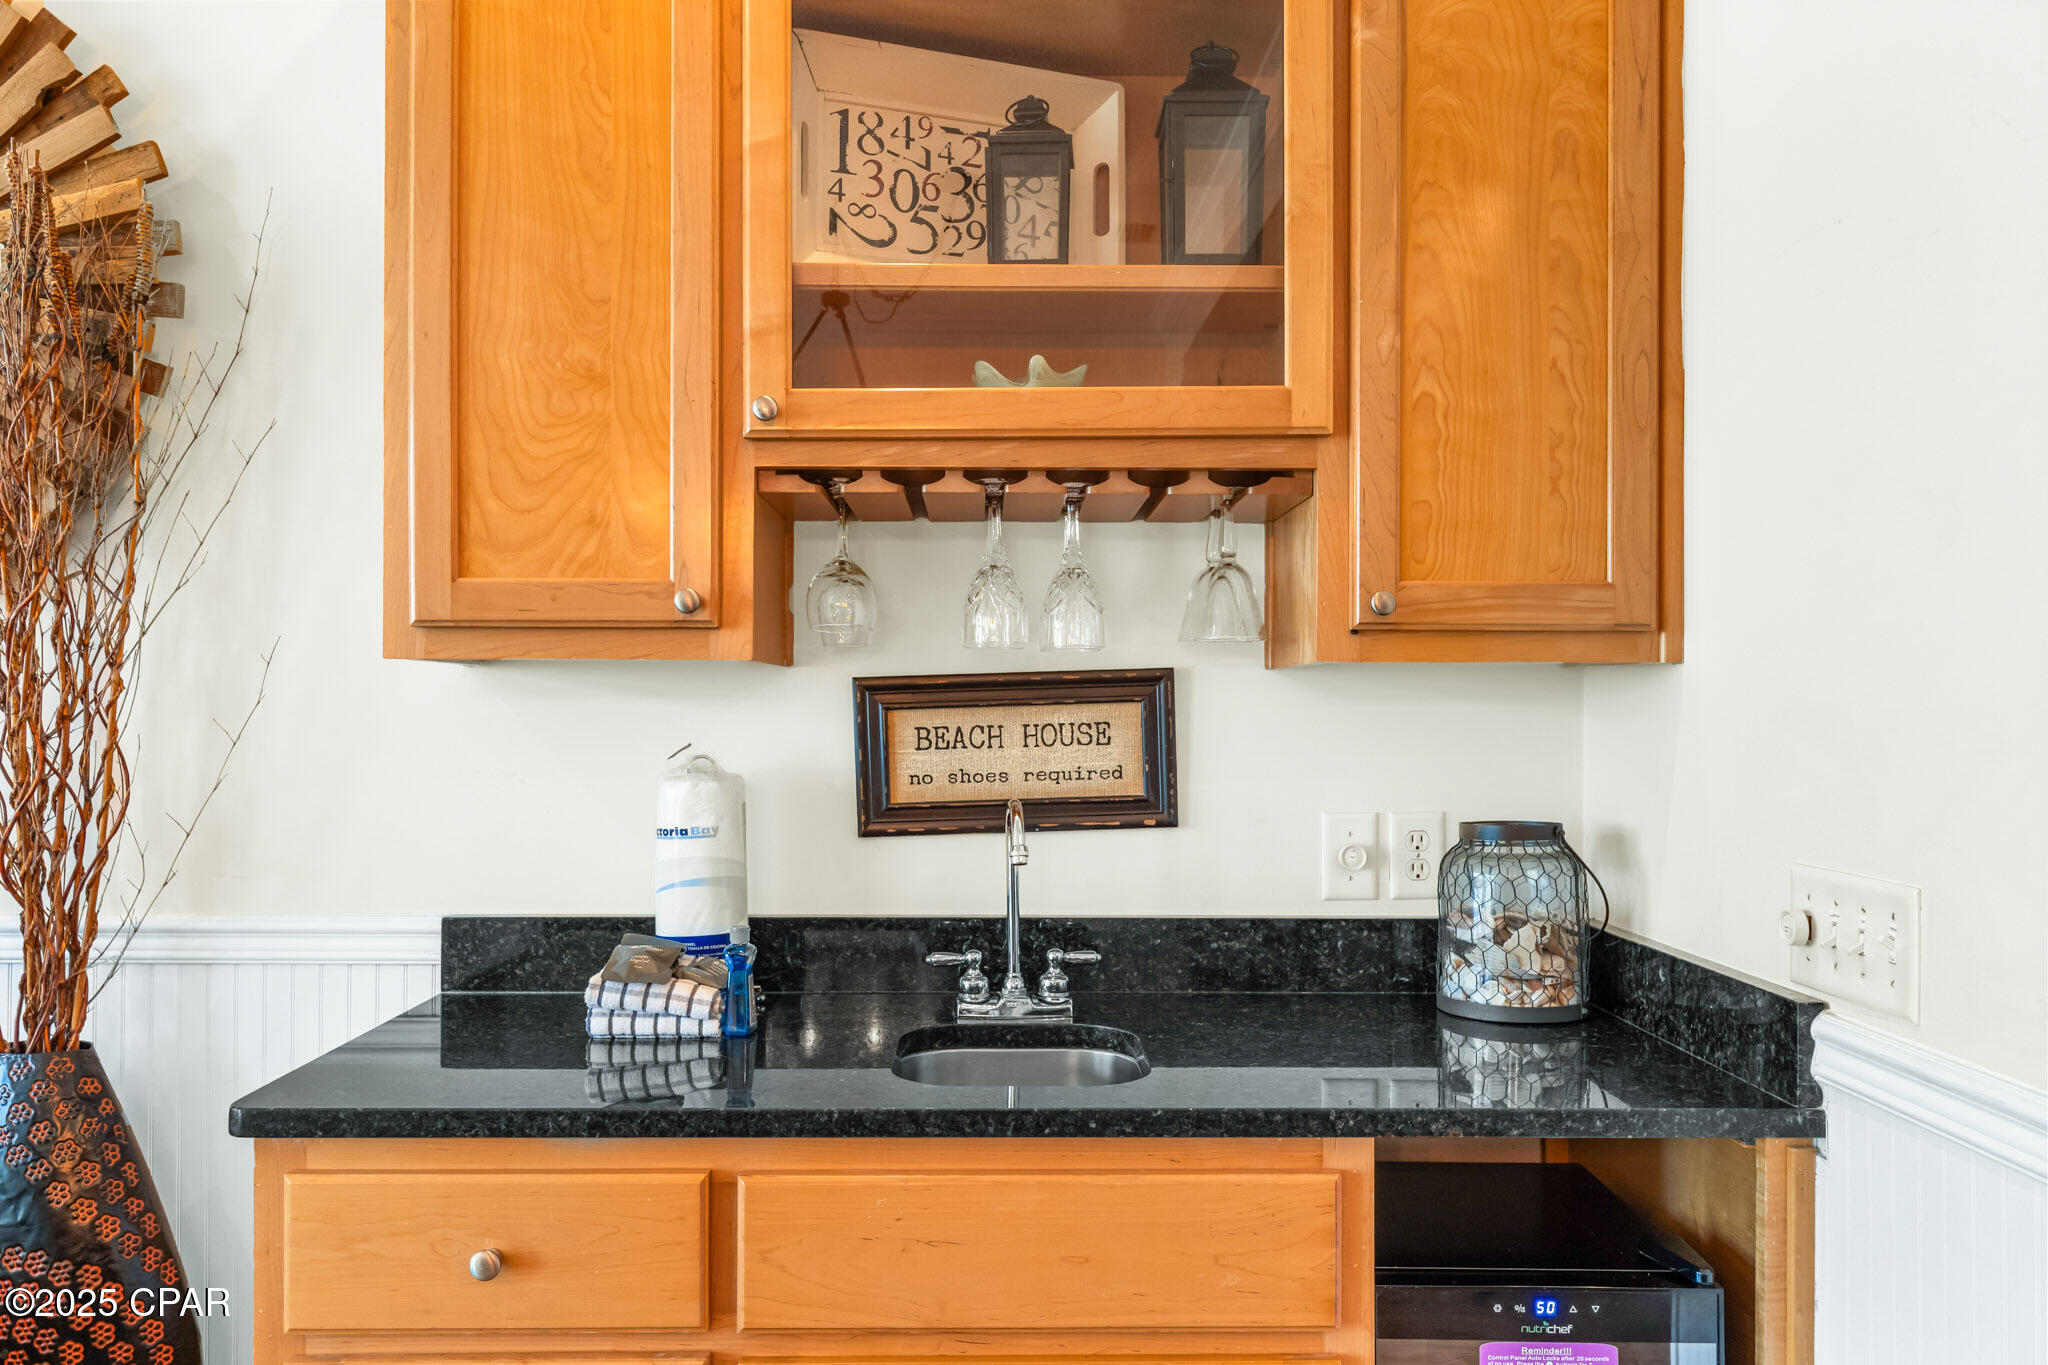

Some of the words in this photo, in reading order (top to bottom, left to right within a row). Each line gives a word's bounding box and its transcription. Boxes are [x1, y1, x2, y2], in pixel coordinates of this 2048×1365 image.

[914, 725, 1004, 751] BEACH
[1022, 721, 1112, 748] HOUSE
[909, 770, 934, 785] no
[948, 767, 1009, 784] shoes
[1023, 765, 1123, 784] required
[690, 826, 719, 837] Bay
[1536, 1301, 1556, 1314] 50
[1520, 1321, 1573, 1334] nutrichef
